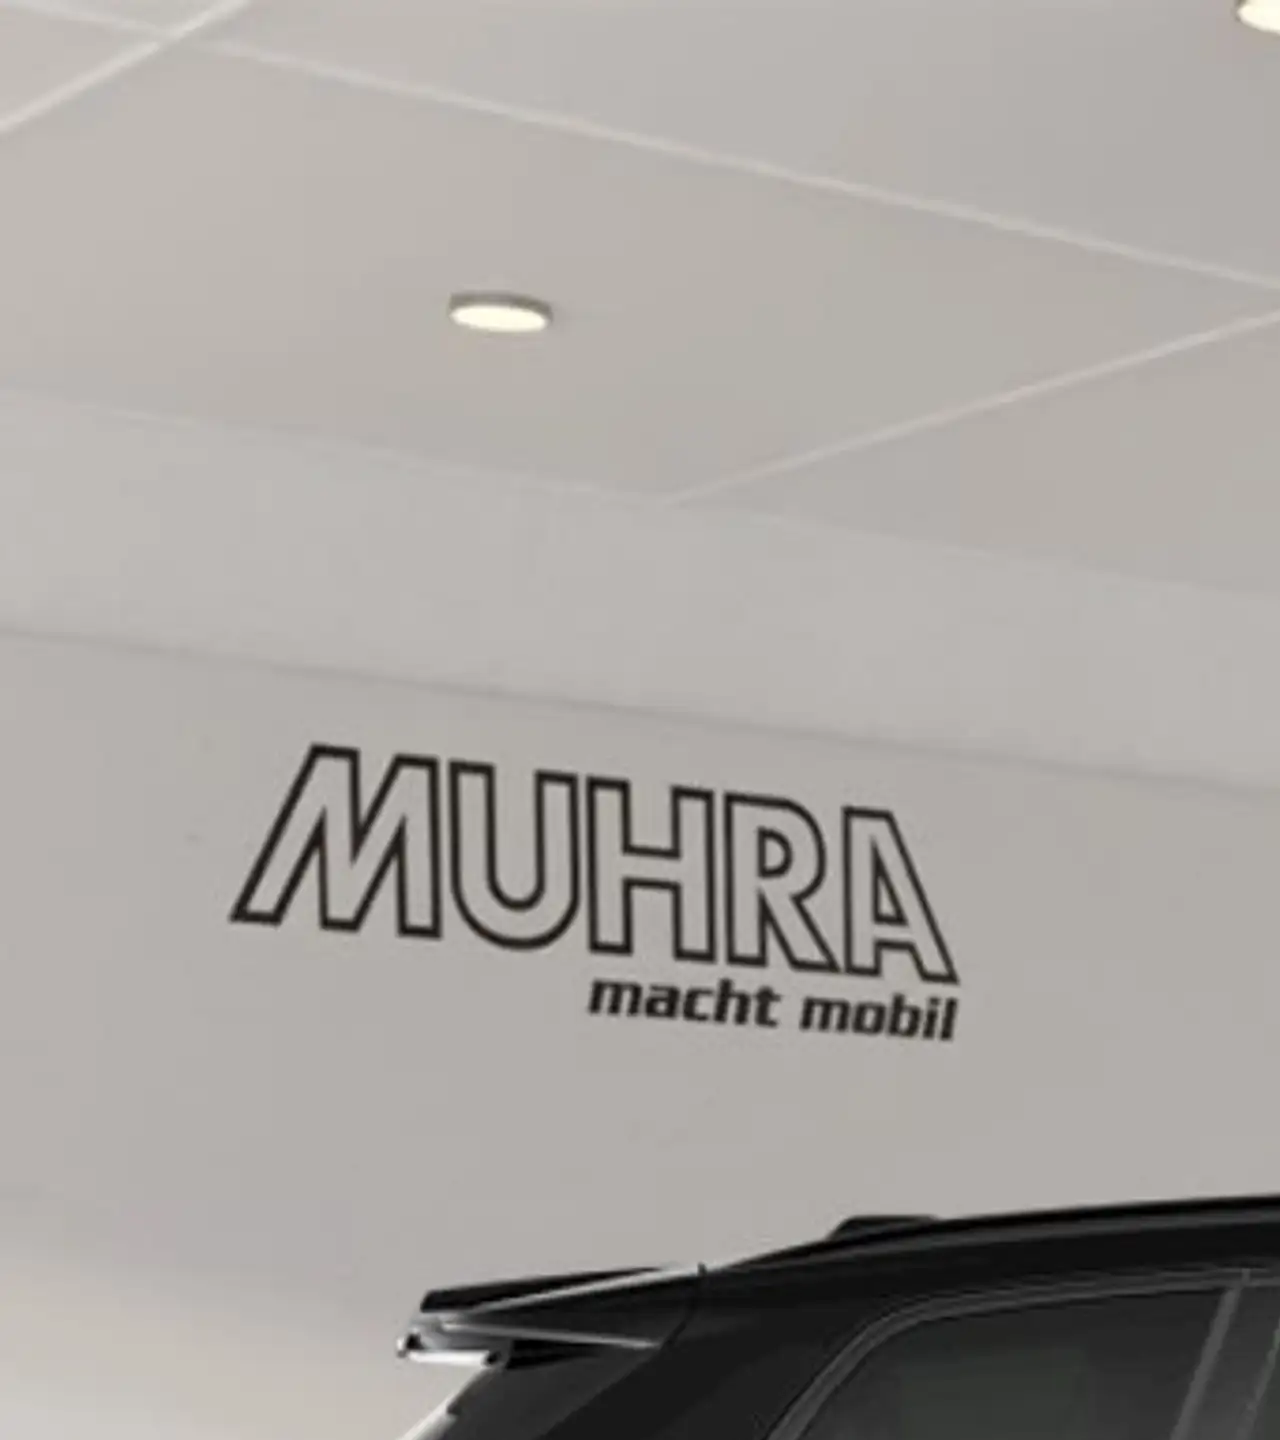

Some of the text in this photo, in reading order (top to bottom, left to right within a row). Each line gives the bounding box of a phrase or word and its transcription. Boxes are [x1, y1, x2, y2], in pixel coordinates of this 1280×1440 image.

[229, 743, 959, 985] MUHRA
[588, 978, 959, 1041] macht mobil
